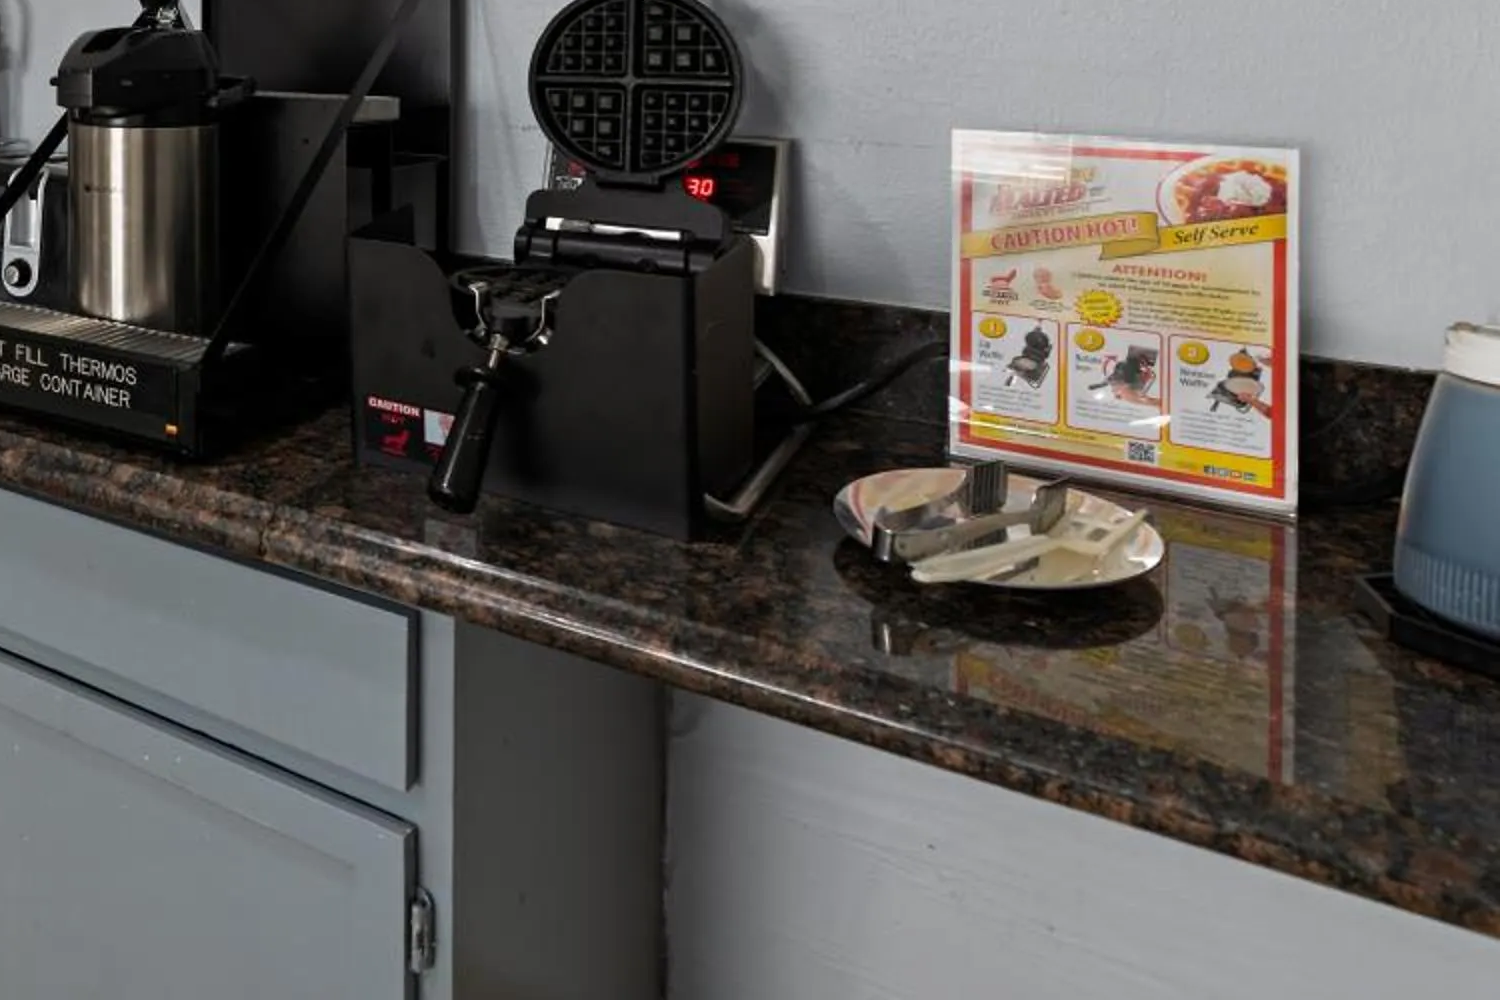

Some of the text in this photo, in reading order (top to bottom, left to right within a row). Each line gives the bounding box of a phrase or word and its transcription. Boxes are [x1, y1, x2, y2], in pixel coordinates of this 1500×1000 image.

[687, 178, 714, 196] 30
[991, 217, 1138, 250] CAUTION HOT!
[1172, 223, 1260, 245] Self Serve
[1111, 263, 1208, 283] ATTENTION!
[15, 343, 50, 368] FILL
[59, 352, 138, 385] THERMOS
[39, 372, 132, 409] CONTAINER
[367, 395, 421, 418] CAUTION
